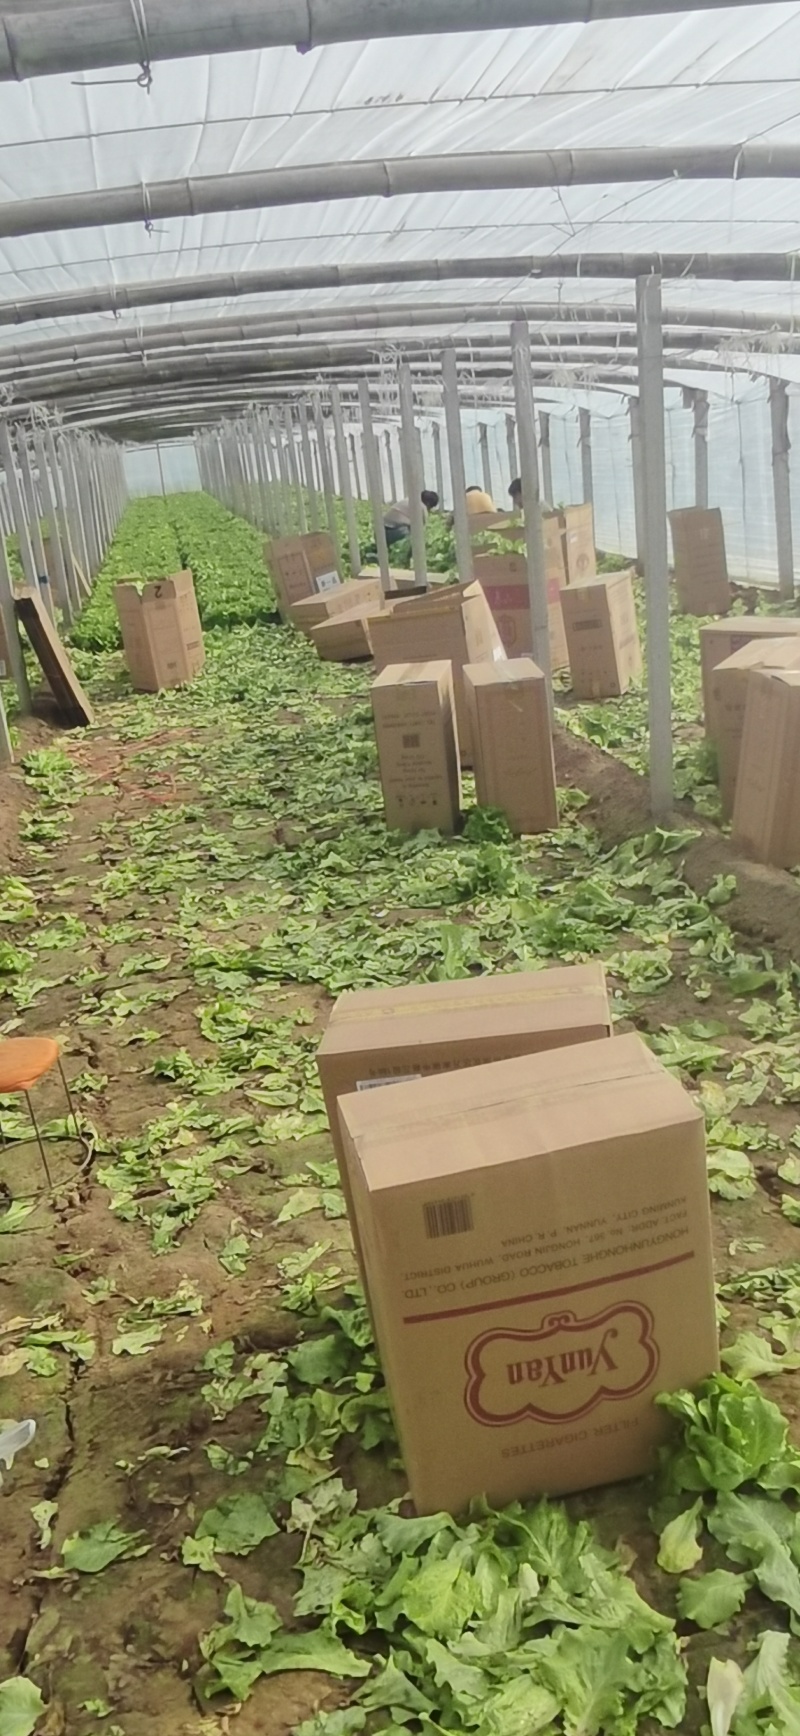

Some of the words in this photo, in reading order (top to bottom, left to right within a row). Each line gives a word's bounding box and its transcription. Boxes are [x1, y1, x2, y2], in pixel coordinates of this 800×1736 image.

[641, 1196, 687, 1215] KUNMING
[500, 1234, 533, 1248] CHINA
[534, 1238, 581, 1256] HONGJIN
[582, 1225, 690, 1264] HONGYUNHONGHE
[454, 1256, 494, 1271] WUHUA
[519, 1257, 579, 1278] TOBACCO
[460, 1269, 516, 1290] (GROUP)
[506, 1327, 619, 1388] YunYan
[594, 1417, 639, 1438] FILTER
[501, 1431, 587, 1459] CIGARETTES
